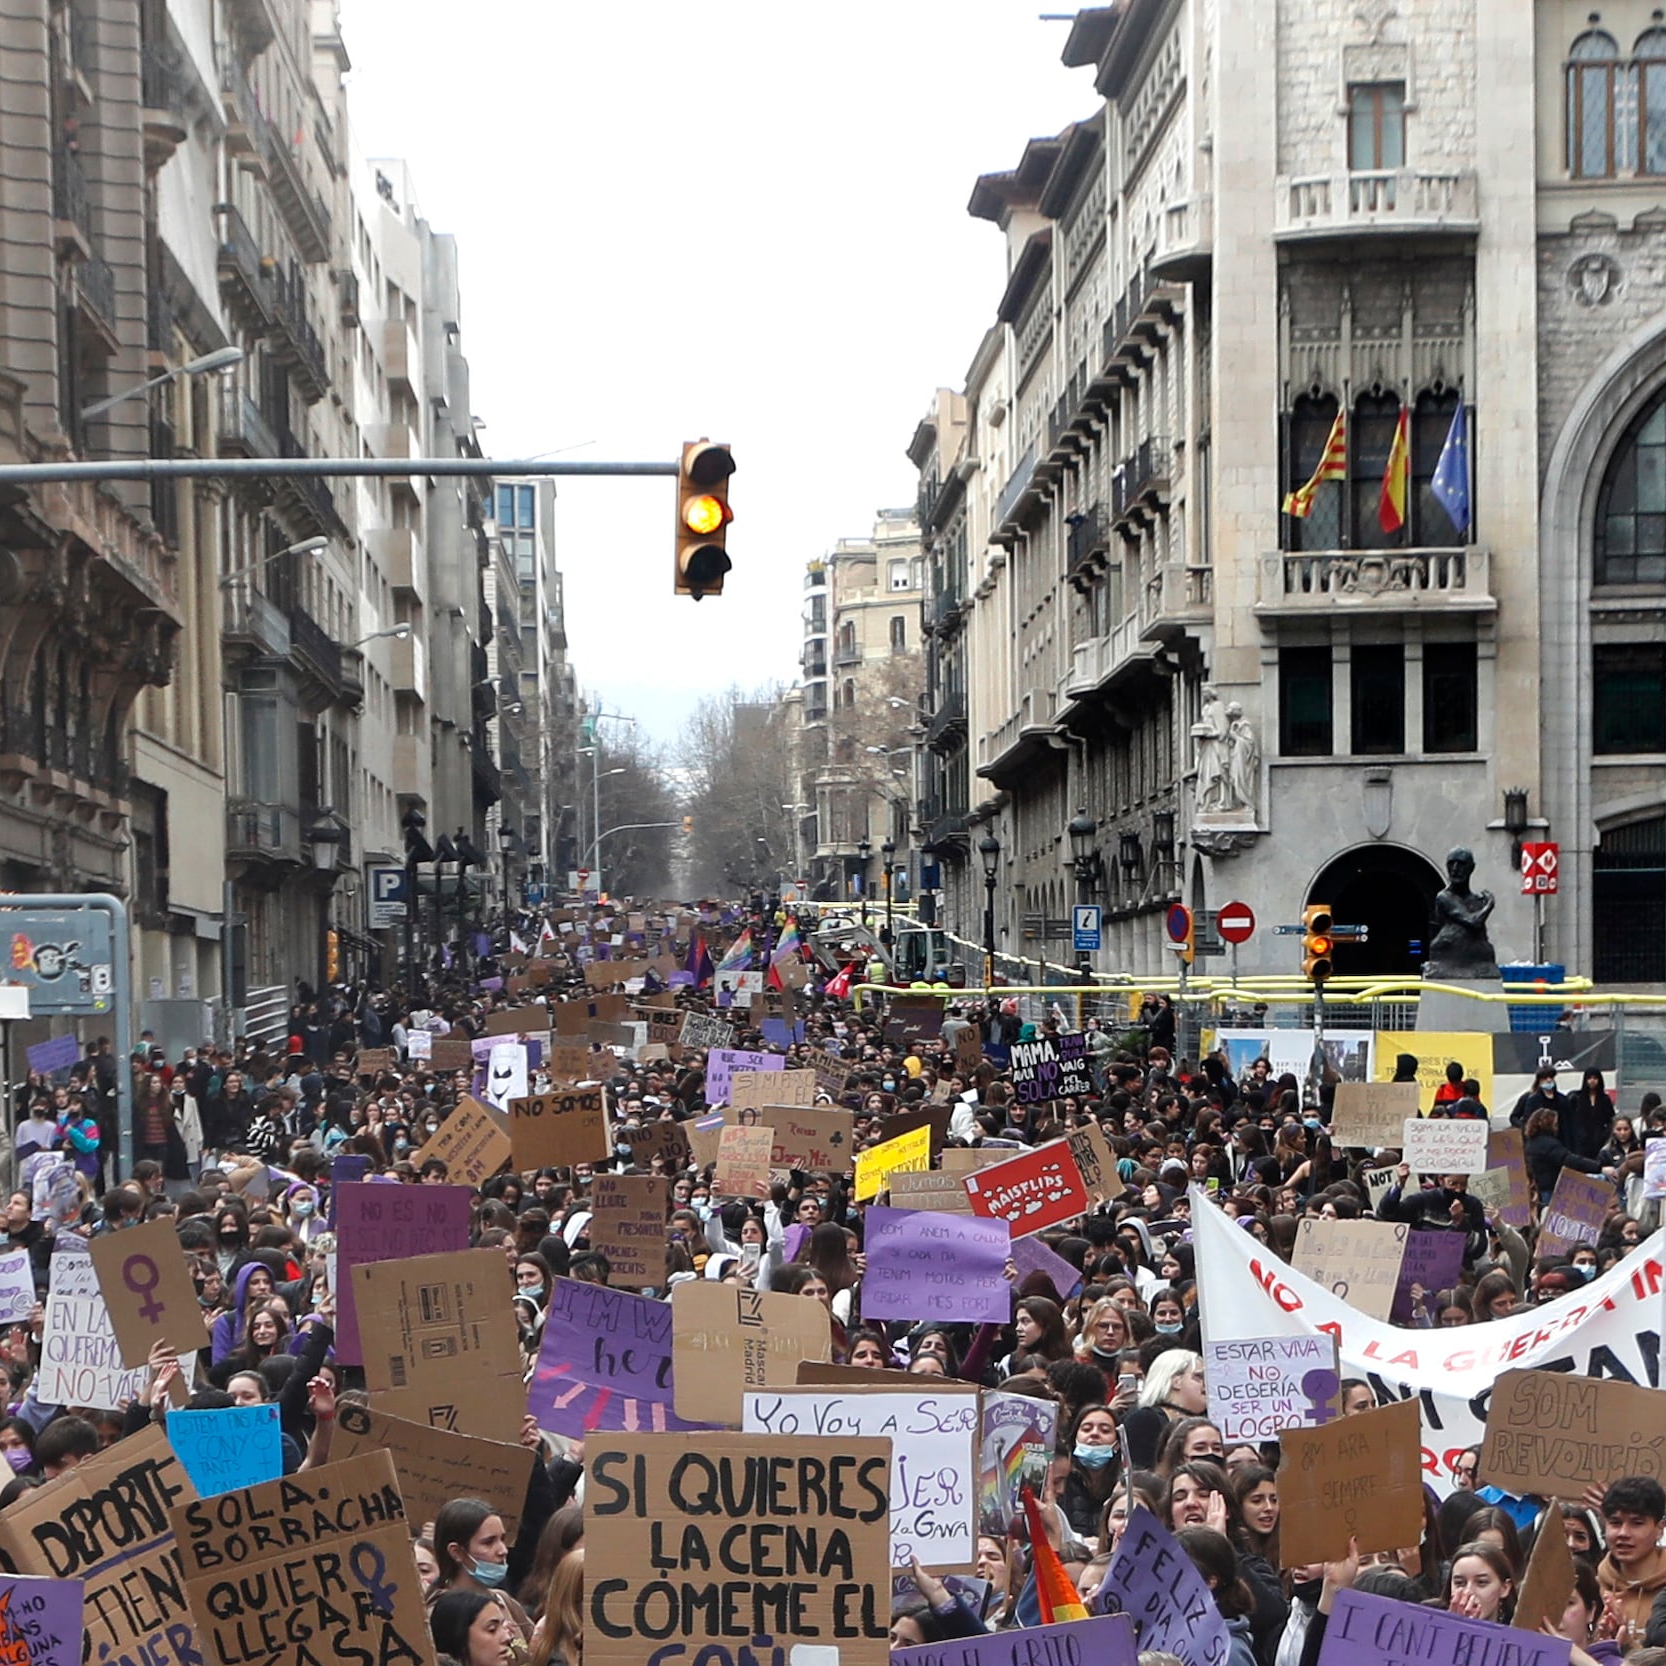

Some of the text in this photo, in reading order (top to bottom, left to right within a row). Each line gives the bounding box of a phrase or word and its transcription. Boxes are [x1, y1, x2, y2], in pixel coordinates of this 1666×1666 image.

[379, 870, 402, 894] P
[1037, 1058, 1085, 1081] NO VAIG
[514, 1093, 601, 1118] NO SOMOS
[1017, 1078, 1058, 1103] SOLA
[1057, 1081, 1091, 1097] CARRER
[1368, 1170, 1394, 1188] NOT
[1247, 1257, 1304, 1314] NO
[1214, 1339, 1321, 1362] ESTAR VIVA
[55, 1366, 97, 1402] NO
[1230, 1399, 1293, 1415] SER UN
[1507, 1374, 1598, 1434] SOM
[1223, 1413, 1302, 1442] LOGRO
[1488, 1429, 1663, 1484] REVOLUCIÓ
[592, 1452, 646, 1517] SI
[669, 1452, 891, 1526] QUIERES
[32, 1456, 184, 1578] DEPORTE
[191, 1484, 406, 1570] BORRACHA
[650, 1521, 854, 1580] LA CENA
[1134, 1530, 1207, 1639] FELIZ
[833, 1583, 890, 1639] EL
